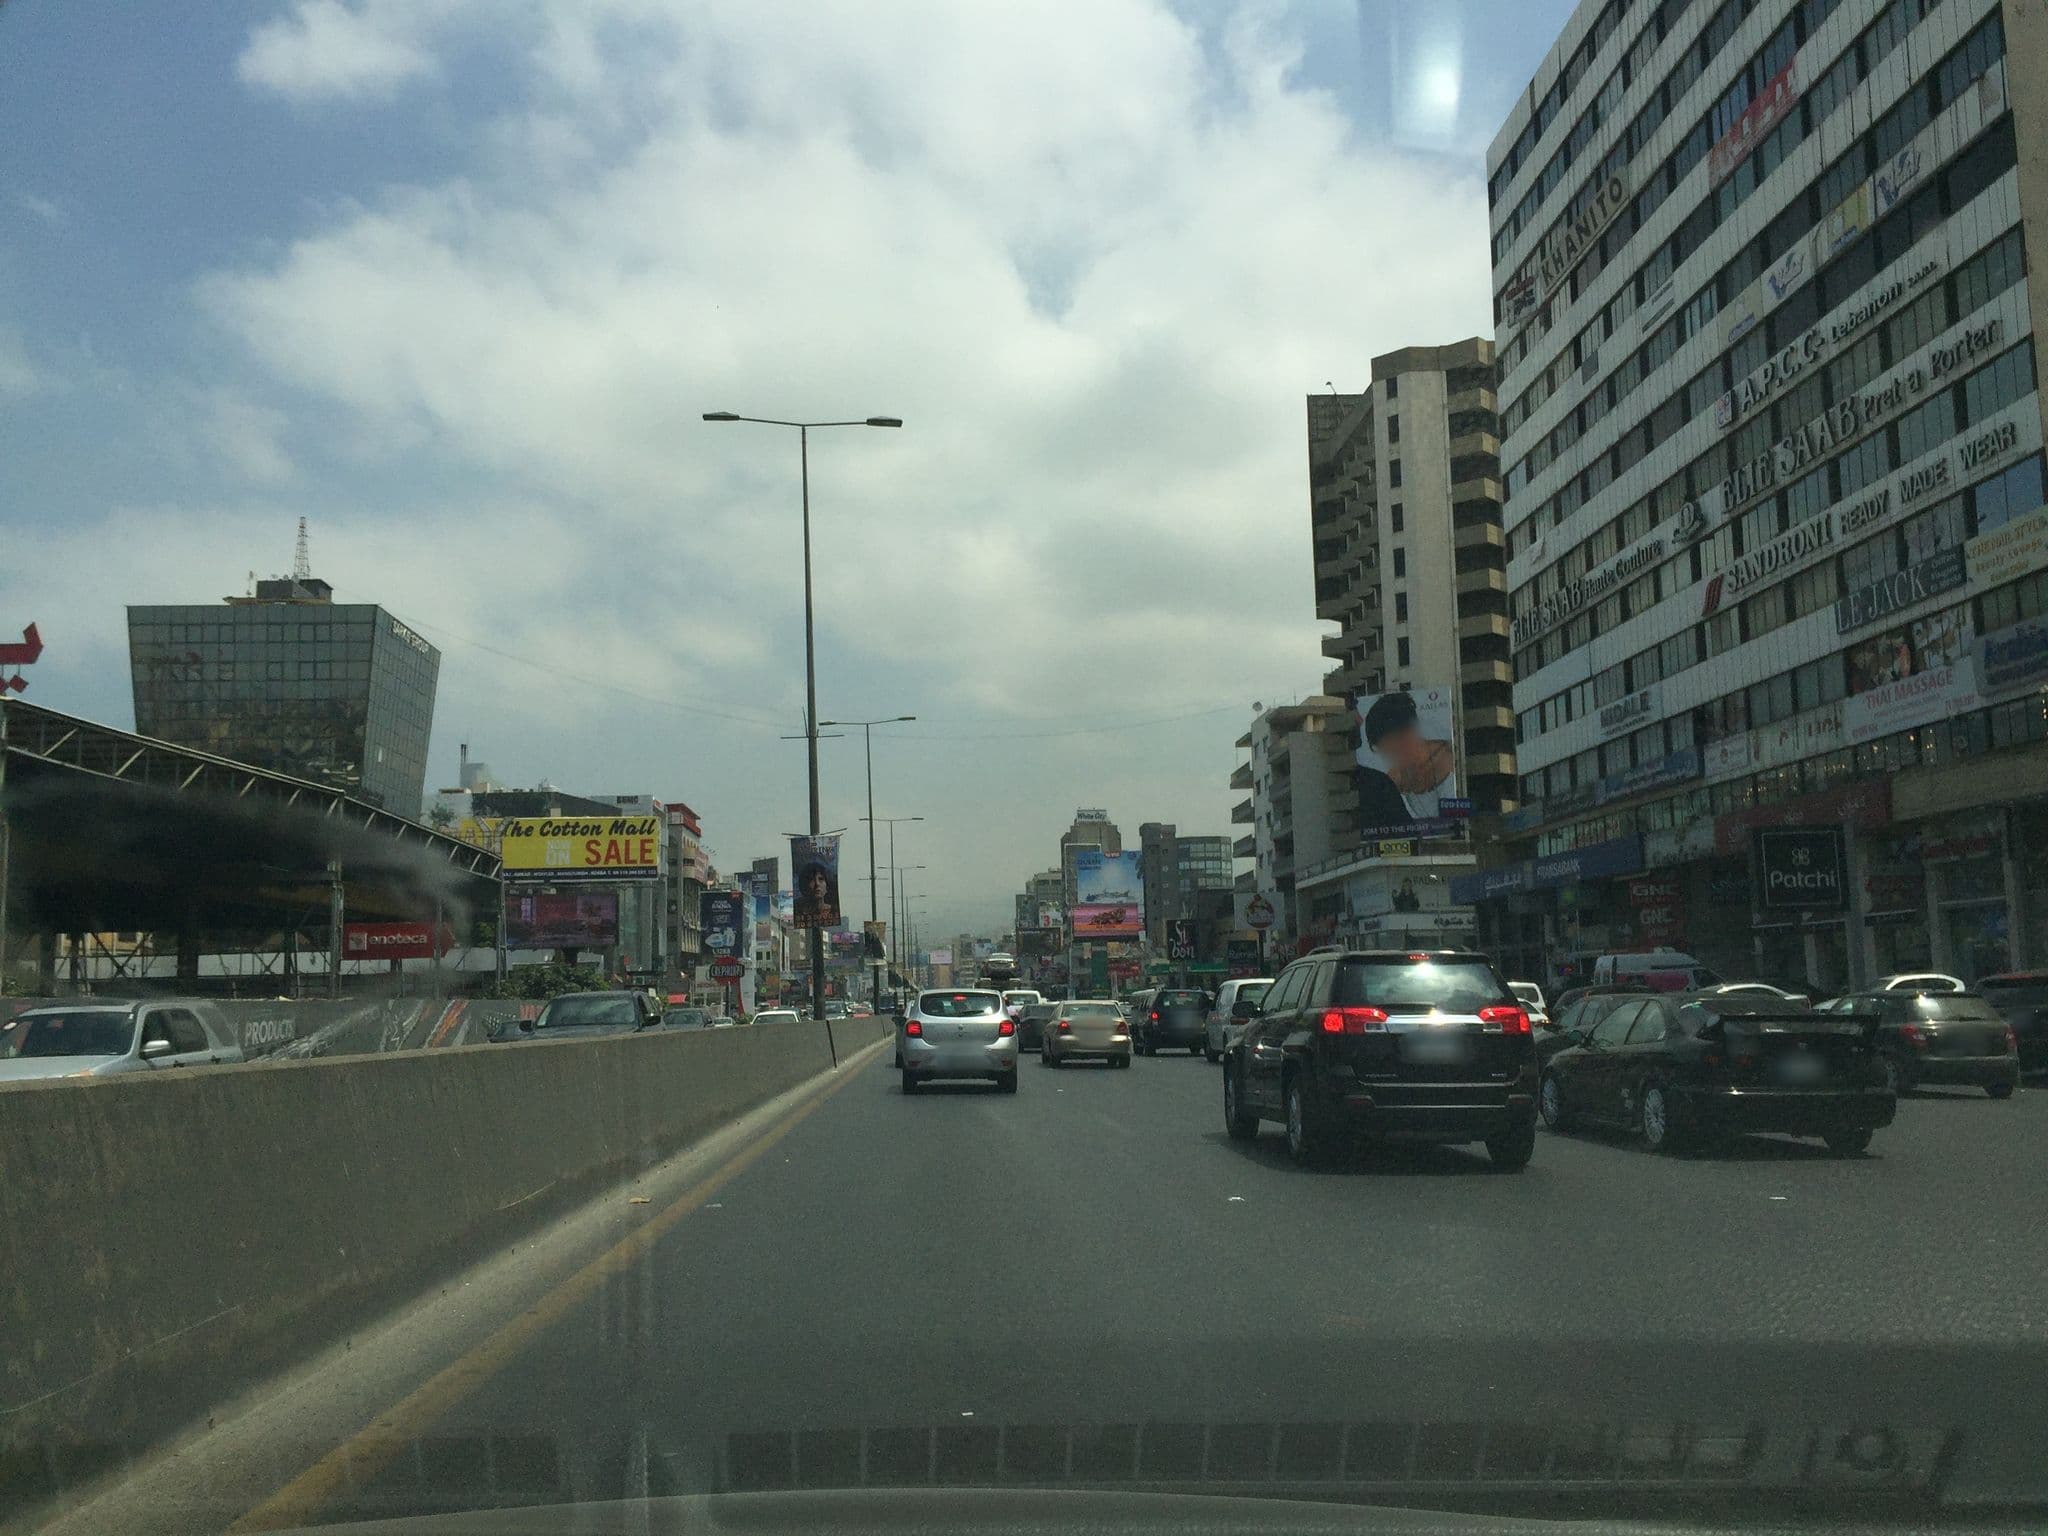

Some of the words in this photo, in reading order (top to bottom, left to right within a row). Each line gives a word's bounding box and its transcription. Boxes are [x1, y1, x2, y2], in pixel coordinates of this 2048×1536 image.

[1541, 176, 1623, 288] KHANITO
[1774, 395, 1859, 477] SAAB
[1929, 320, 2004, 379] Porter
[1725, 513, 1834, 594] SANDRONI
[1838, 488, 1890, 535] READY
[1899, 457, 1951, 503] MADE
[1958, 420, 2017, 472] WEAR
[1542, 579, 1584, 626] SAAB
[1866, 563, 1928, 620] JACK
[1893, 667, 1955, 701] MASSAGE
[539, 820, 603, 837] Cotton
[608, 818, 657, 836] Mall
[584, 838, 655, 866] SALE
[1768, 869, 1836, 889] Patchi
[368, 932, 428, 945] enoteca
[1169, 938, 1196, 959] bon
